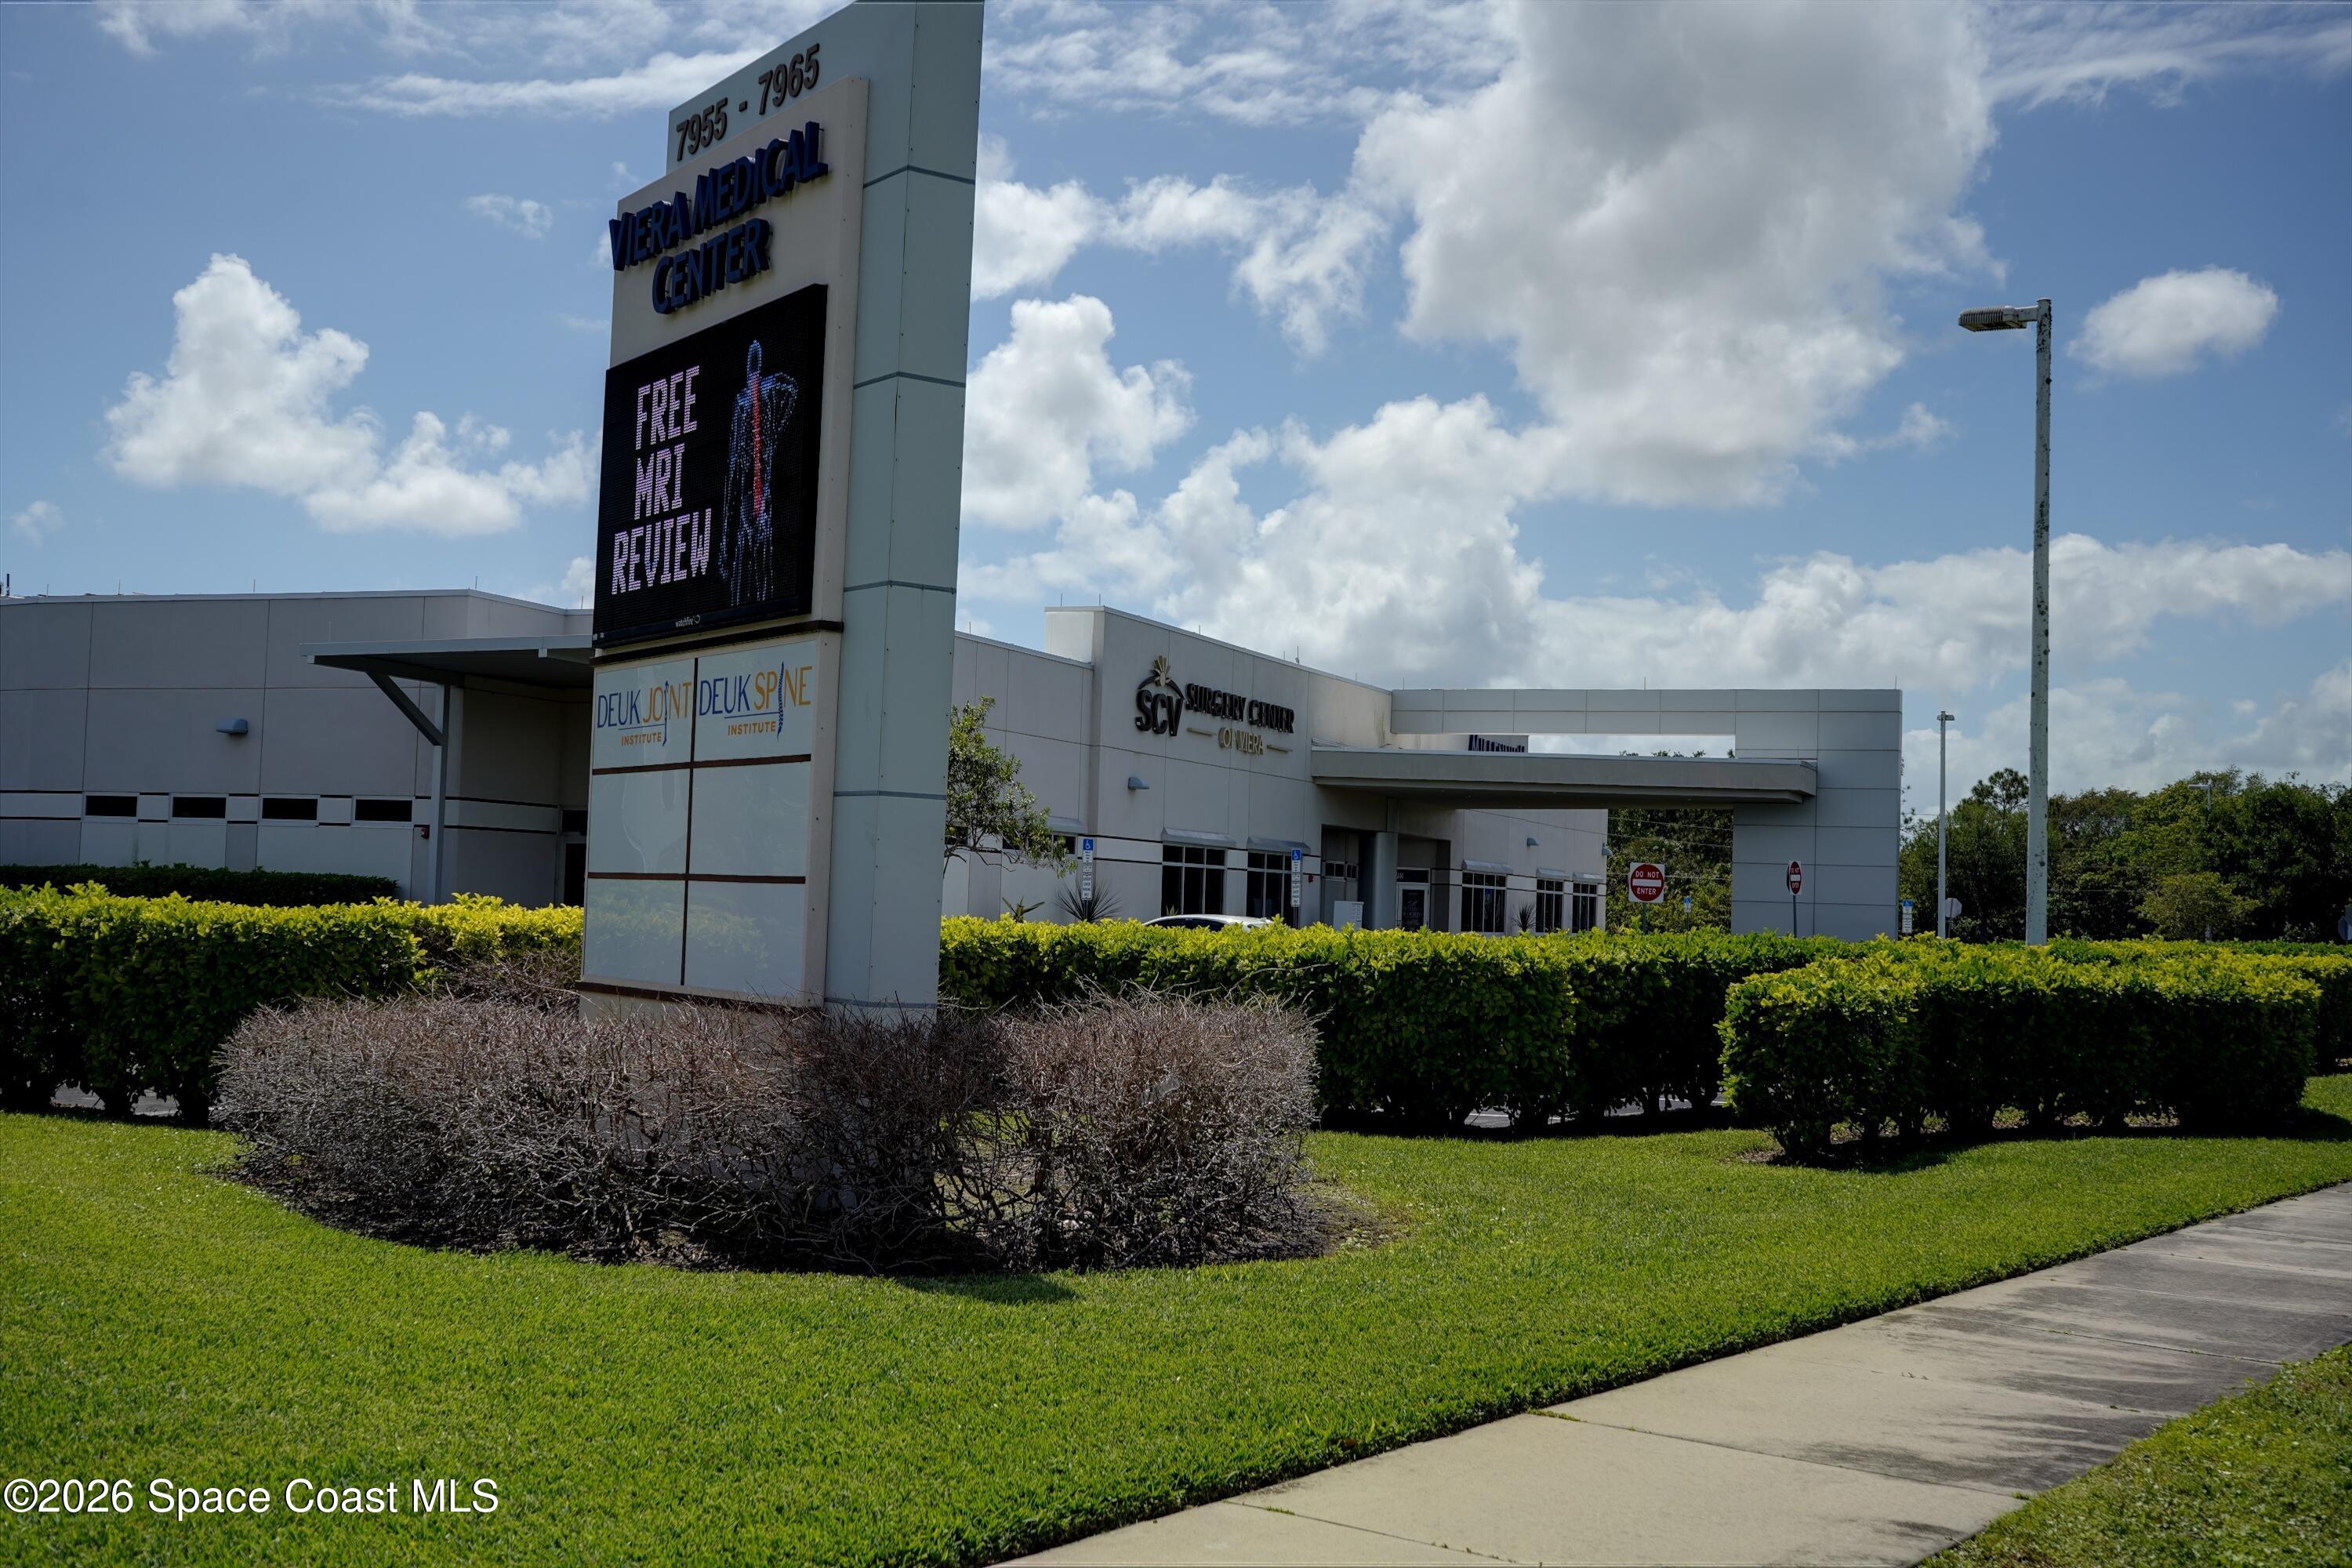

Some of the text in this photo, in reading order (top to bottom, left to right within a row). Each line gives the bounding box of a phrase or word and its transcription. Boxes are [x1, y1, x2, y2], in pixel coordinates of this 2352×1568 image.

[676, 97, 728, 162] 7955
[758, 42, 820, 115] 7965
[609, 121, 829, 271] VIERA MEDICAL
[652, 218, 772, 314] CENTER
[636, 365, 700, 451] FREE
[633, 442, 686, 521] MRI
[611, 507, 712, 595] REVIEW
[597, 689, 641, 728] DEUK
[699, 673, 752, 717] DEUK
[1135, 689, 1184, 737] SCV
[1185, 683, 1294, 734] SURGERY CENTER
[621, 731, 662, 746] INSTITUTE
[728, 720, 776, 736] INSTITUTE
[1236, 730, 1264, 754] VIERA
